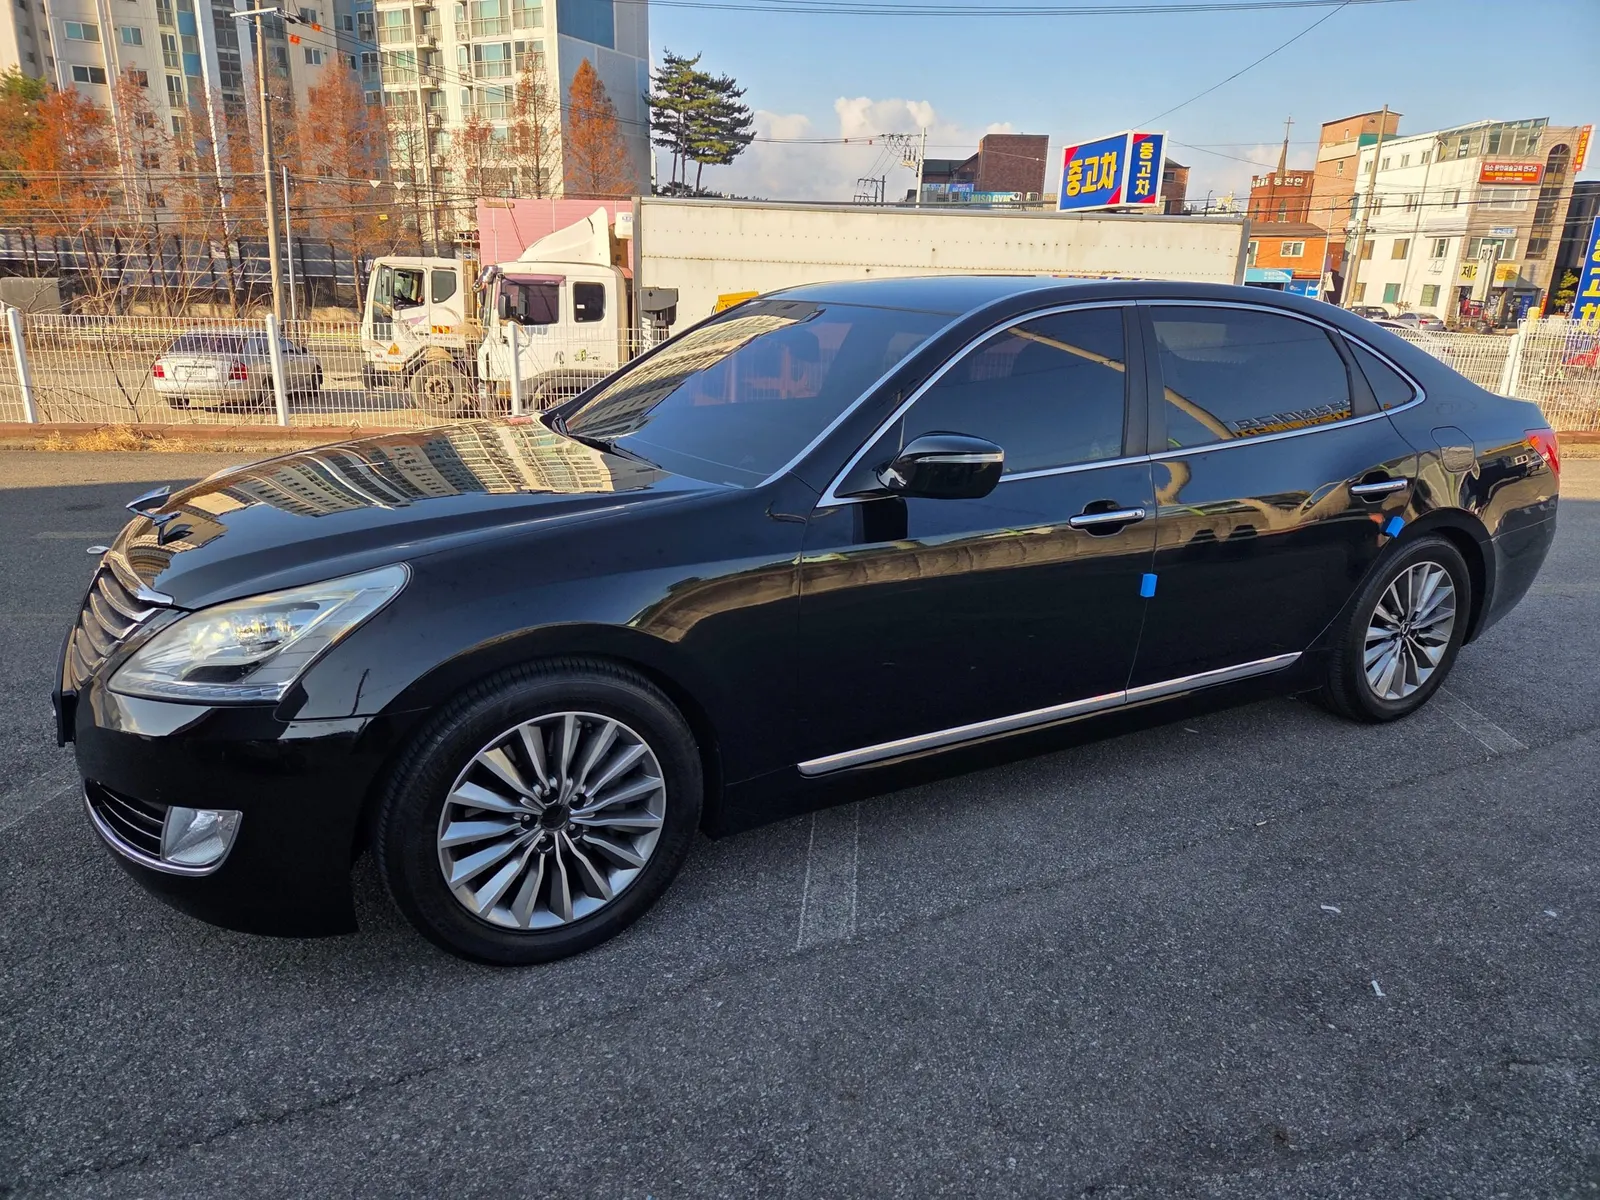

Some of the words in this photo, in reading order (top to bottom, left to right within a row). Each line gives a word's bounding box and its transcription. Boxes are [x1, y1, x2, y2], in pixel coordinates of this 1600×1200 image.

[1066, 151, 1117, 196] 중고차
[1134, 142, 1154, 195] 중고차
[971, 194, 992, 203] MISO
